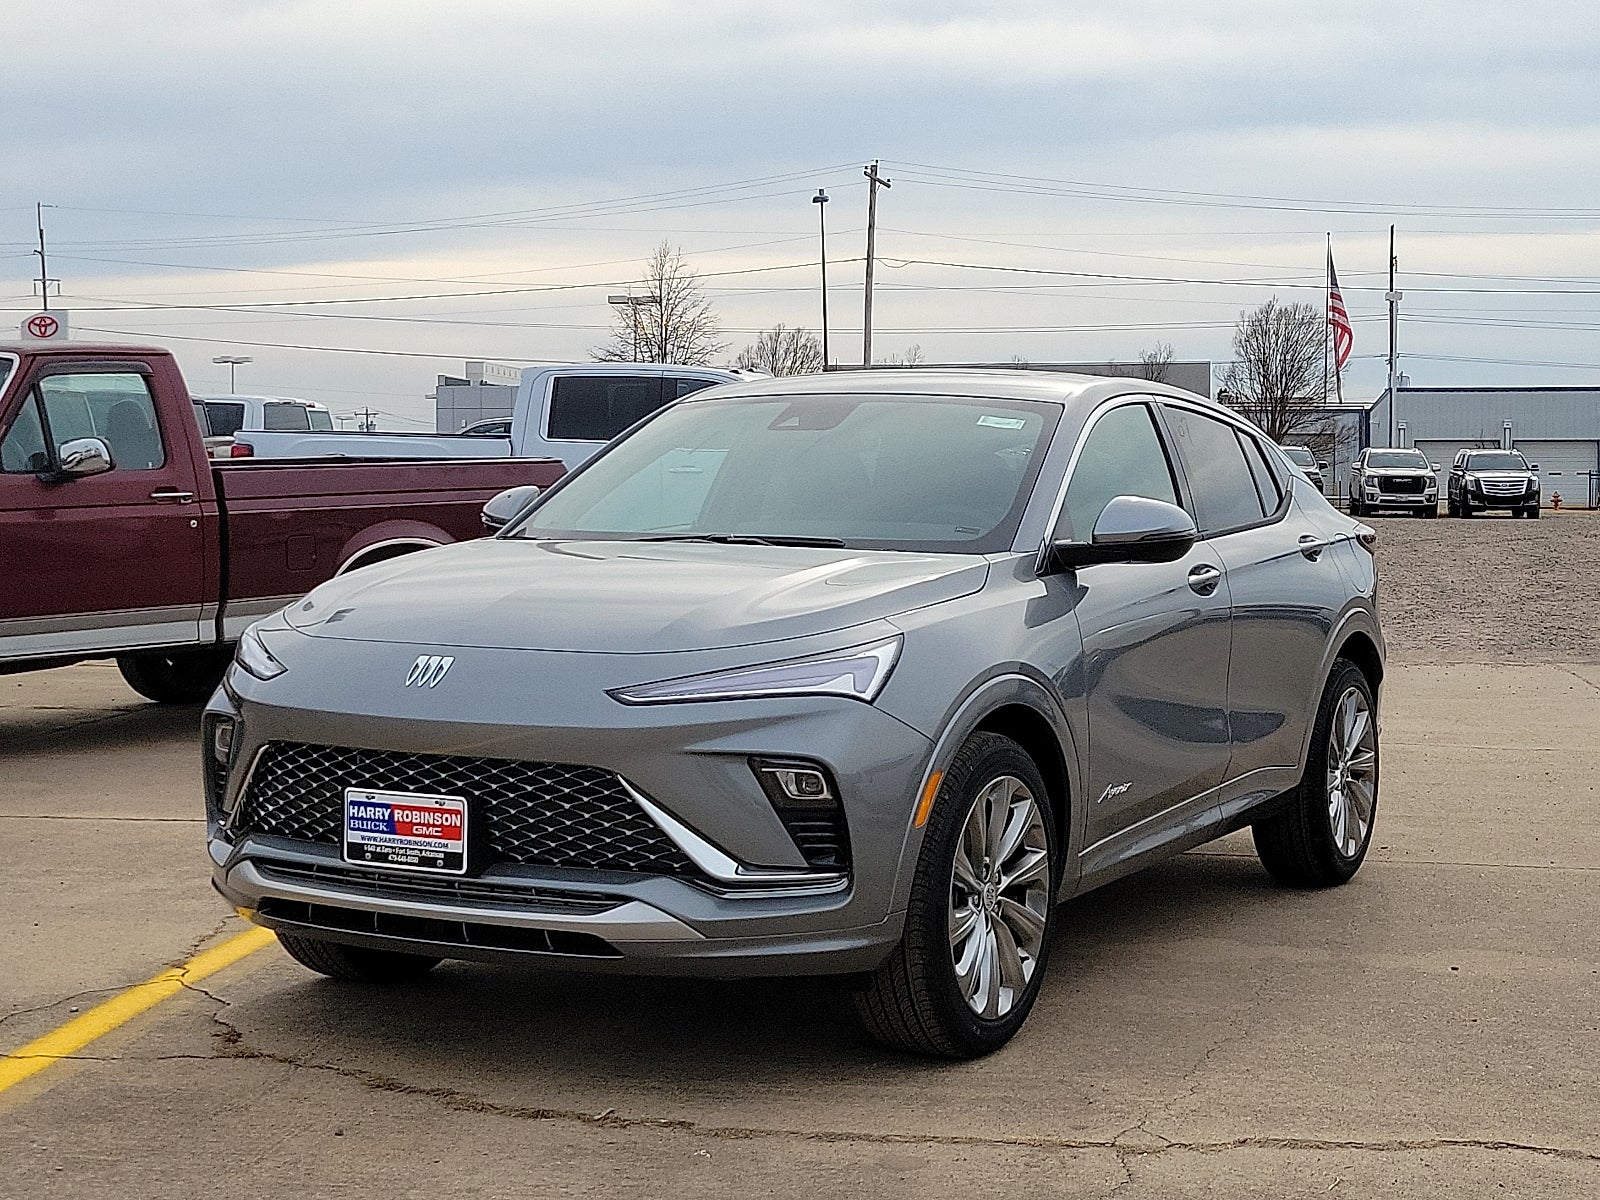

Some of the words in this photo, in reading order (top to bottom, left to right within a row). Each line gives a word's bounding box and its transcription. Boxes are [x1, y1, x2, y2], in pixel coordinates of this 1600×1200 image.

[349, 805, 392, 820] HARRY
[393, 809, 461, 827] ROBINSON
[350, 819, 388, 831] BUICK
[412, 825, 443, 836] GMC
[360, 834, 450, 849] WWW.HARRYROBINSON.COM
